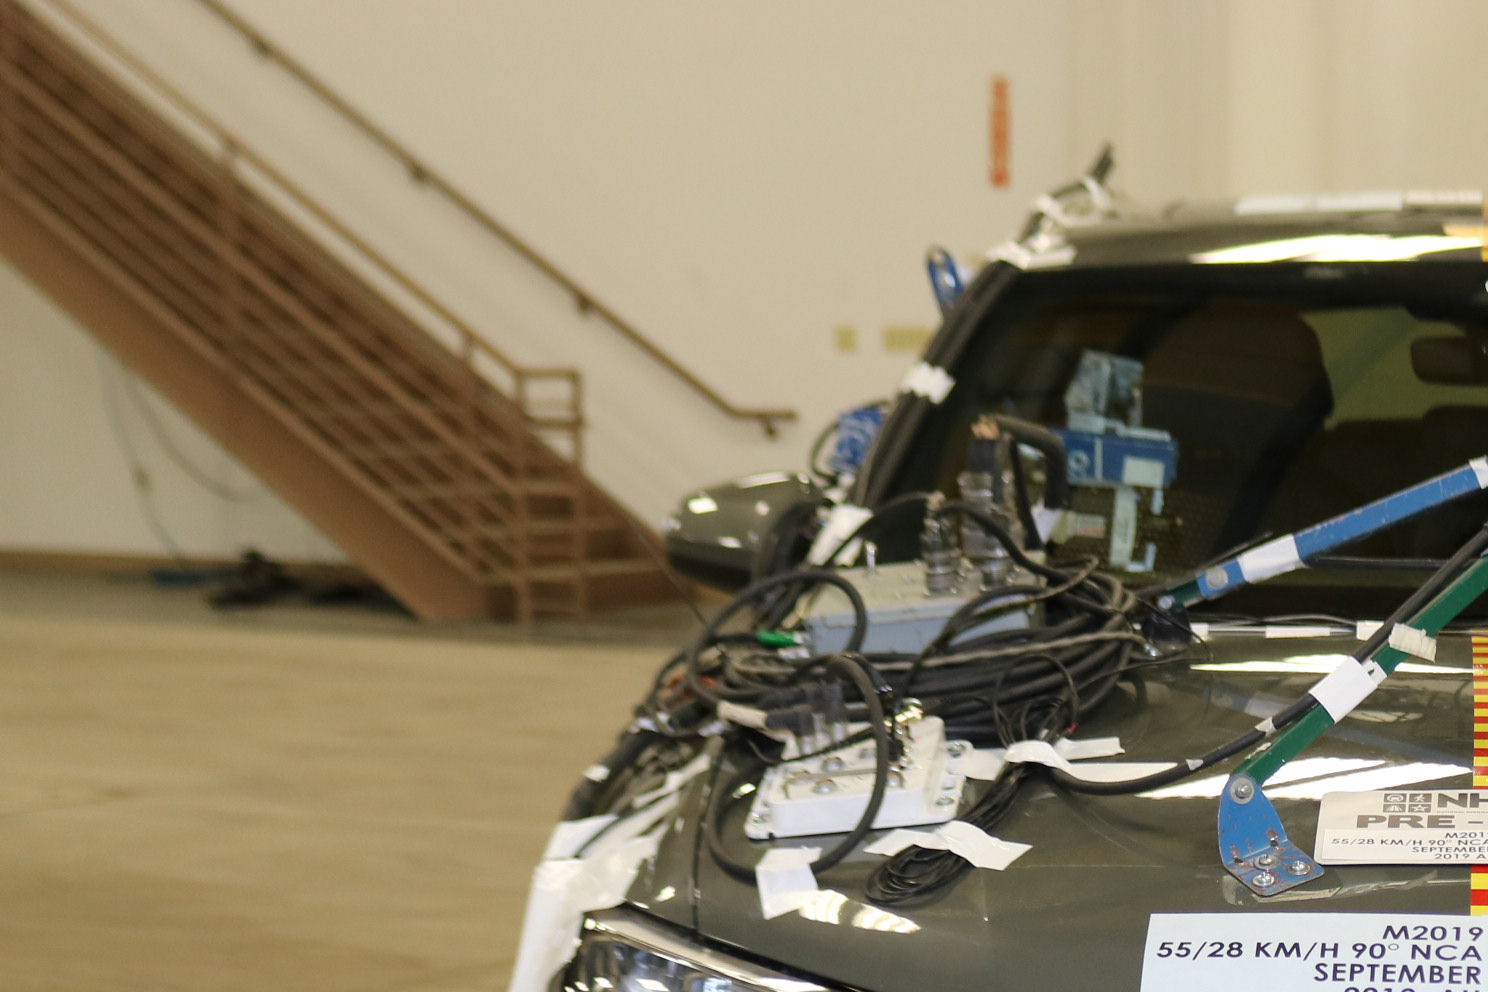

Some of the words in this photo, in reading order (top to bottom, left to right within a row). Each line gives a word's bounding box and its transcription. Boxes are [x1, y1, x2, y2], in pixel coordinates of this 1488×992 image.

[1356, 814, 1456, 829] PRE
[1380, 838, 1423, 847] KM/H
[1156, 941, 1244, 961] 55/28
[1254, 942, 1339, 961] KM/H
[1313, 962, 1482, 985] SEPTEMBER
